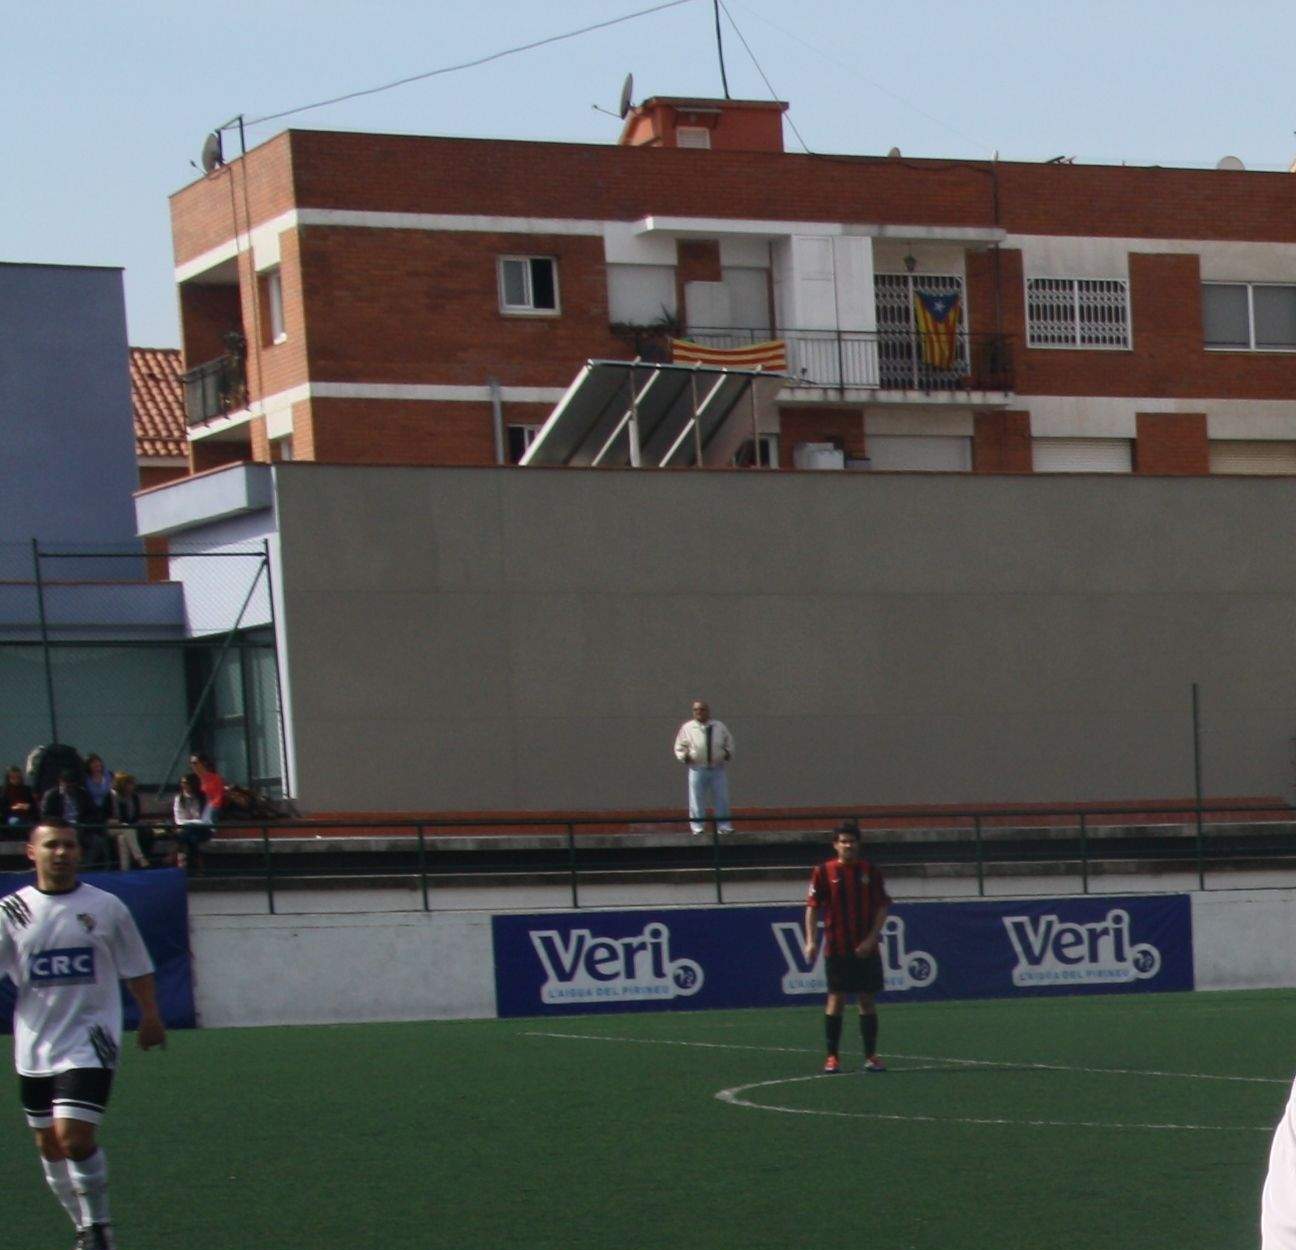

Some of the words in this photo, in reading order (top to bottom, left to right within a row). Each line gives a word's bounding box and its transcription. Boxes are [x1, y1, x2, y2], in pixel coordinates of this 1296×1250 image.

[32, 954, 92, 976] CRC
[536, 926, 668, 983] Veri
[779, 919, 903, 974] Vi
[1009, 912, 1129, 966] Veri
